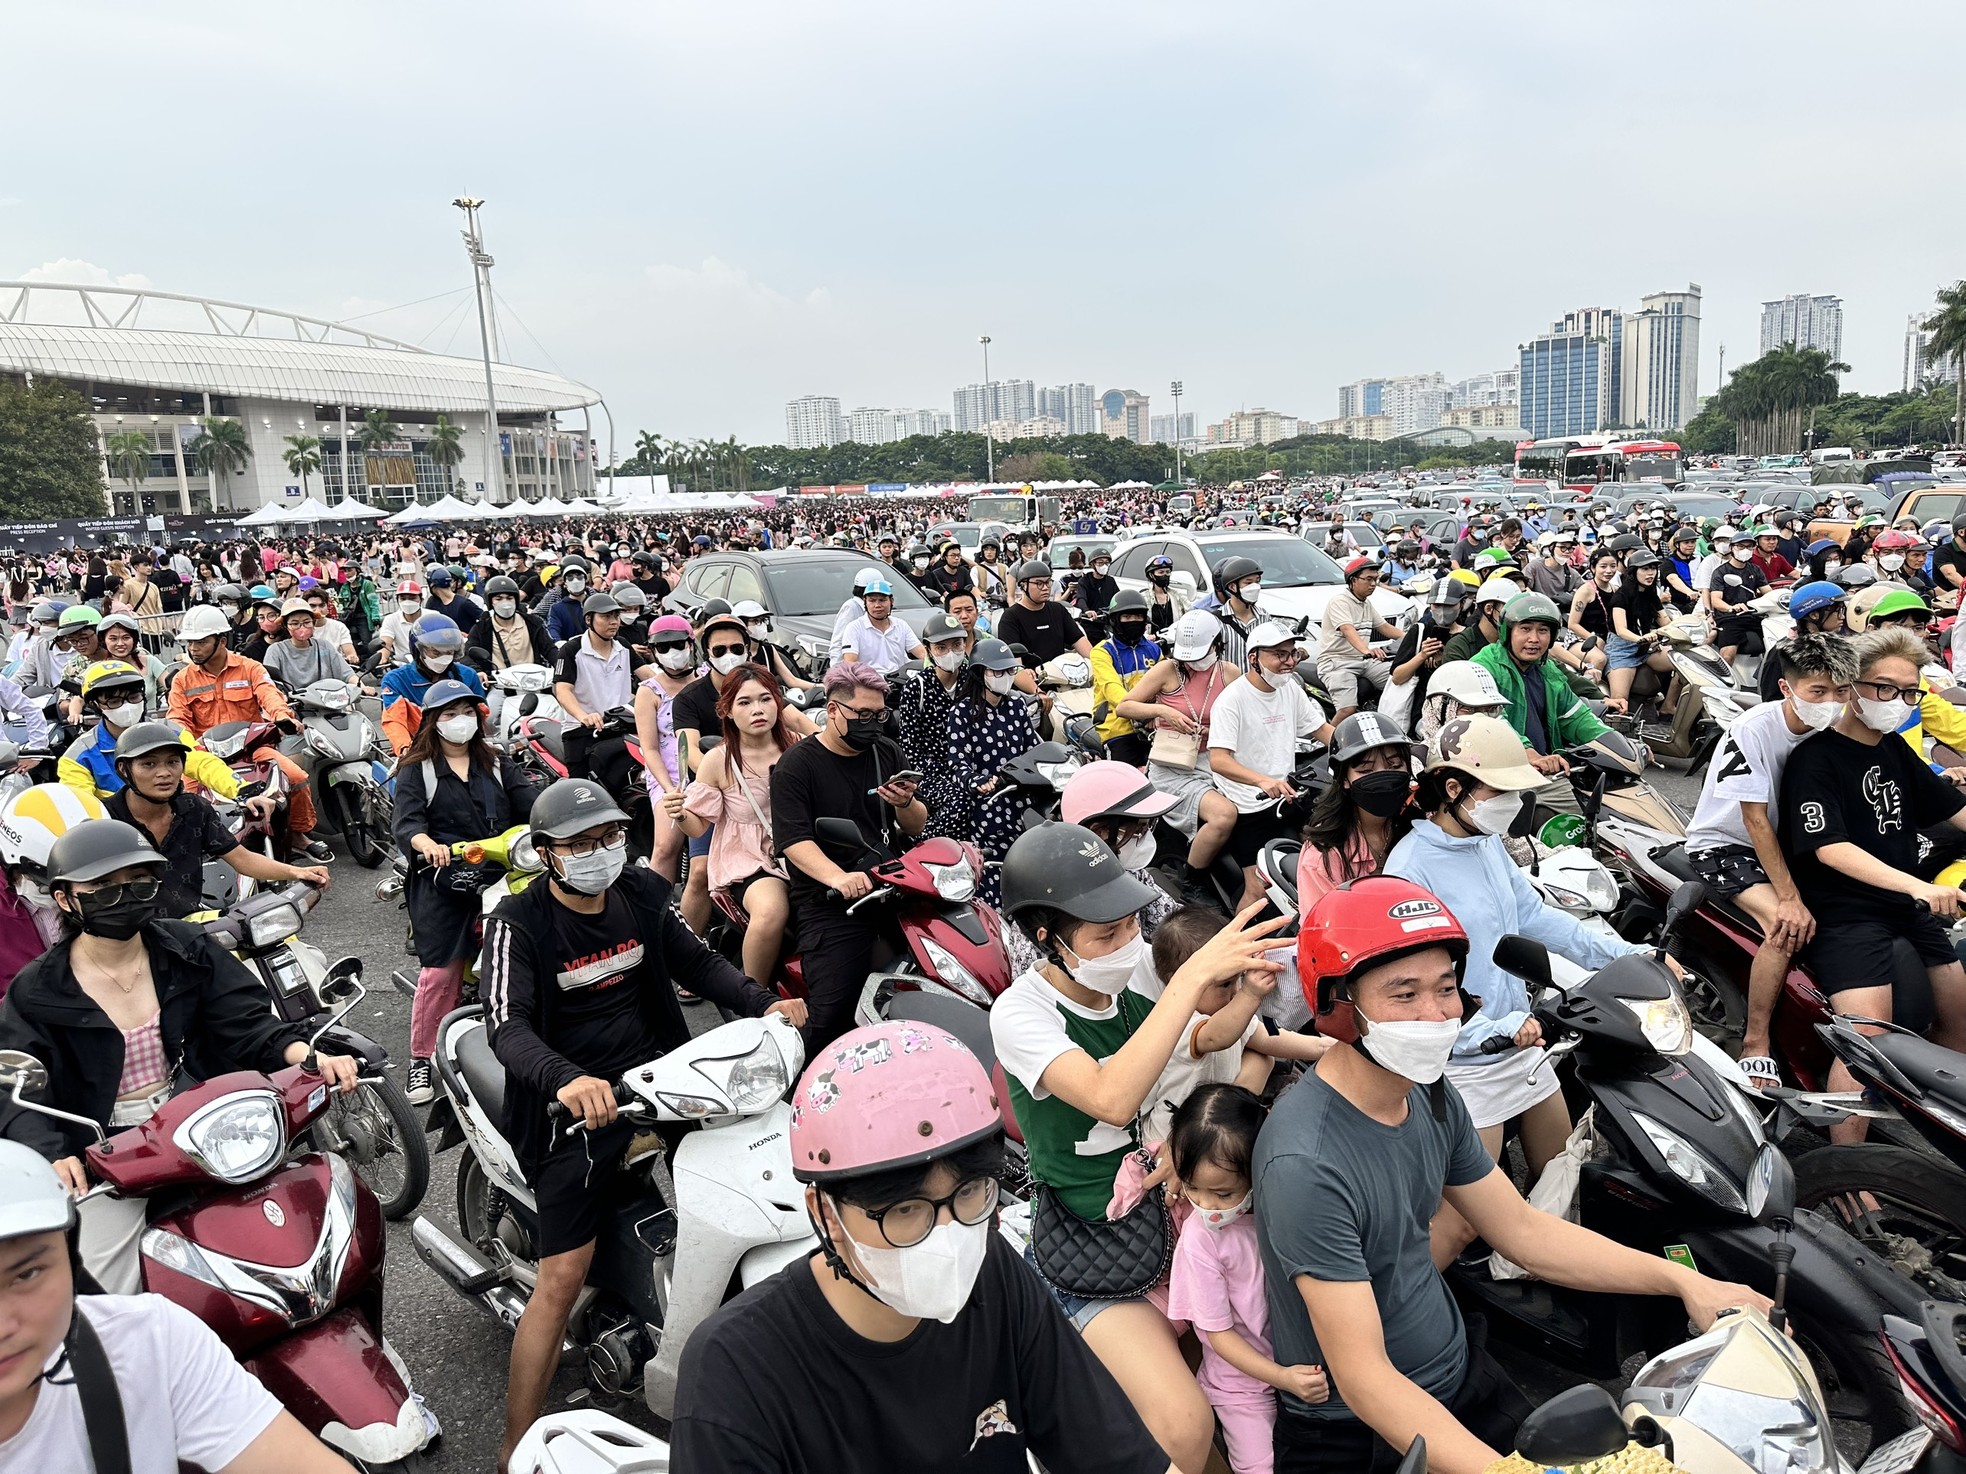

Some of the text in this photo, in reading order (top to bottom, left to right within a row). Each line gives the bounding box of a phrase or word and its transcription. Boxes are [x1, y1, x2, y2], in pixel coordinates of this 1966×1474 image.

[1529, 606, 1550, 614] Grab
[102, 662, 123, 670] be
[1143, 654, 1156, 668] be
[1800, 802, 1825, 833] 3
[0, 819, 23, 844] ENEOS
[1565, 823, 1586, 840] Grab
[1089, 853, 1109, 867] adidas
[1397, 902, 1436, 916] HJC
[748, 1132, 782, 1151] HONDA
[243, 1183, 278, 1200] HONDA
